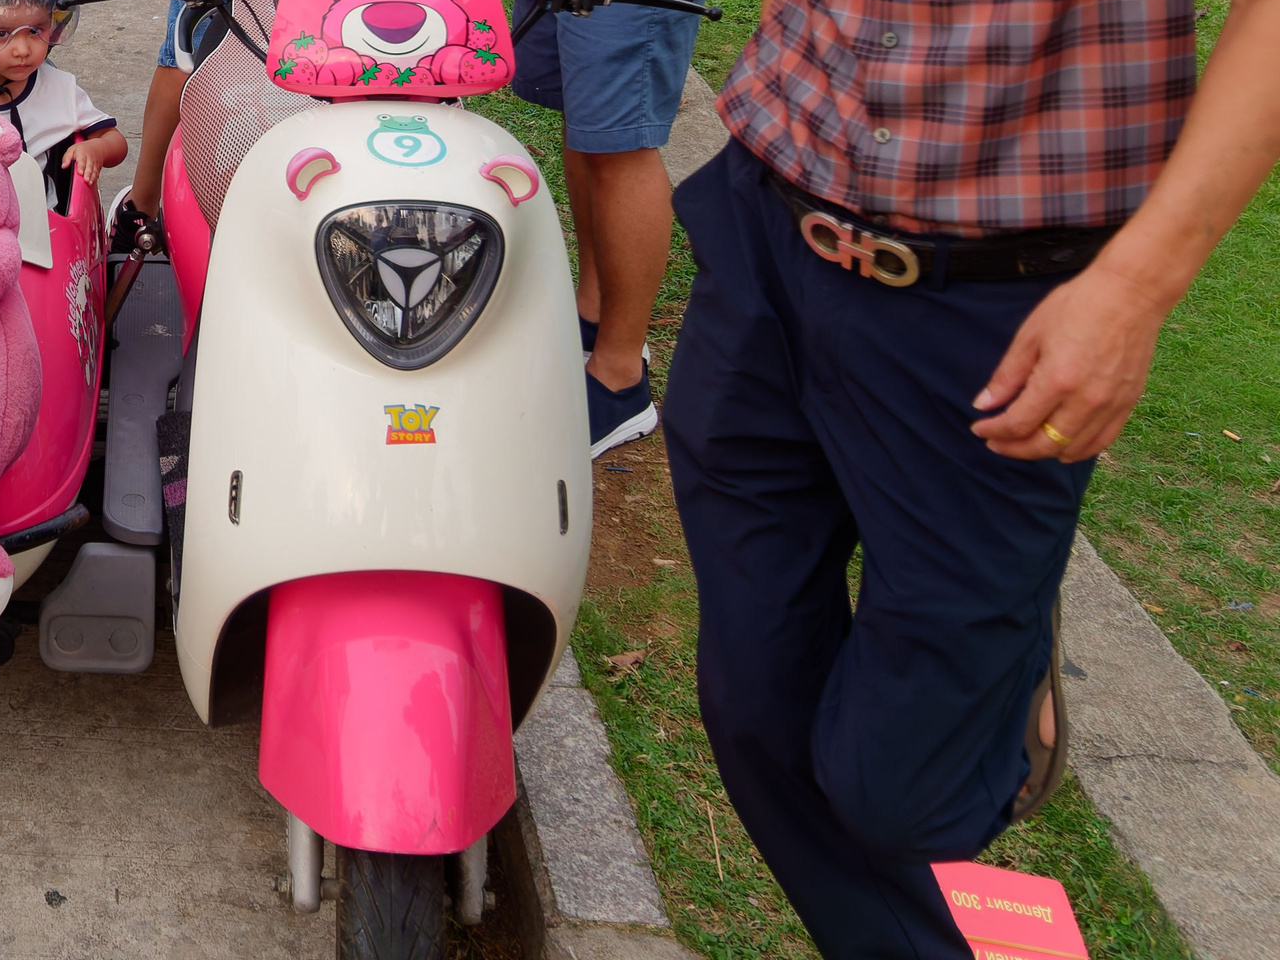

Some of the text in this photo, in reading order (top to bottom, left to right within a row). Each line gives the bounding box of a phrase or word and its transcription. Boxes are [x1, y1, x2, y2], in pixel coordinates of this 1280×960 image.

[393, 134, 423, 159] 9
[383, 403, 441, 432] TOY
[390, 431, 431, 443] STORY
[950, 889, 1053, 924] Депозит 300
